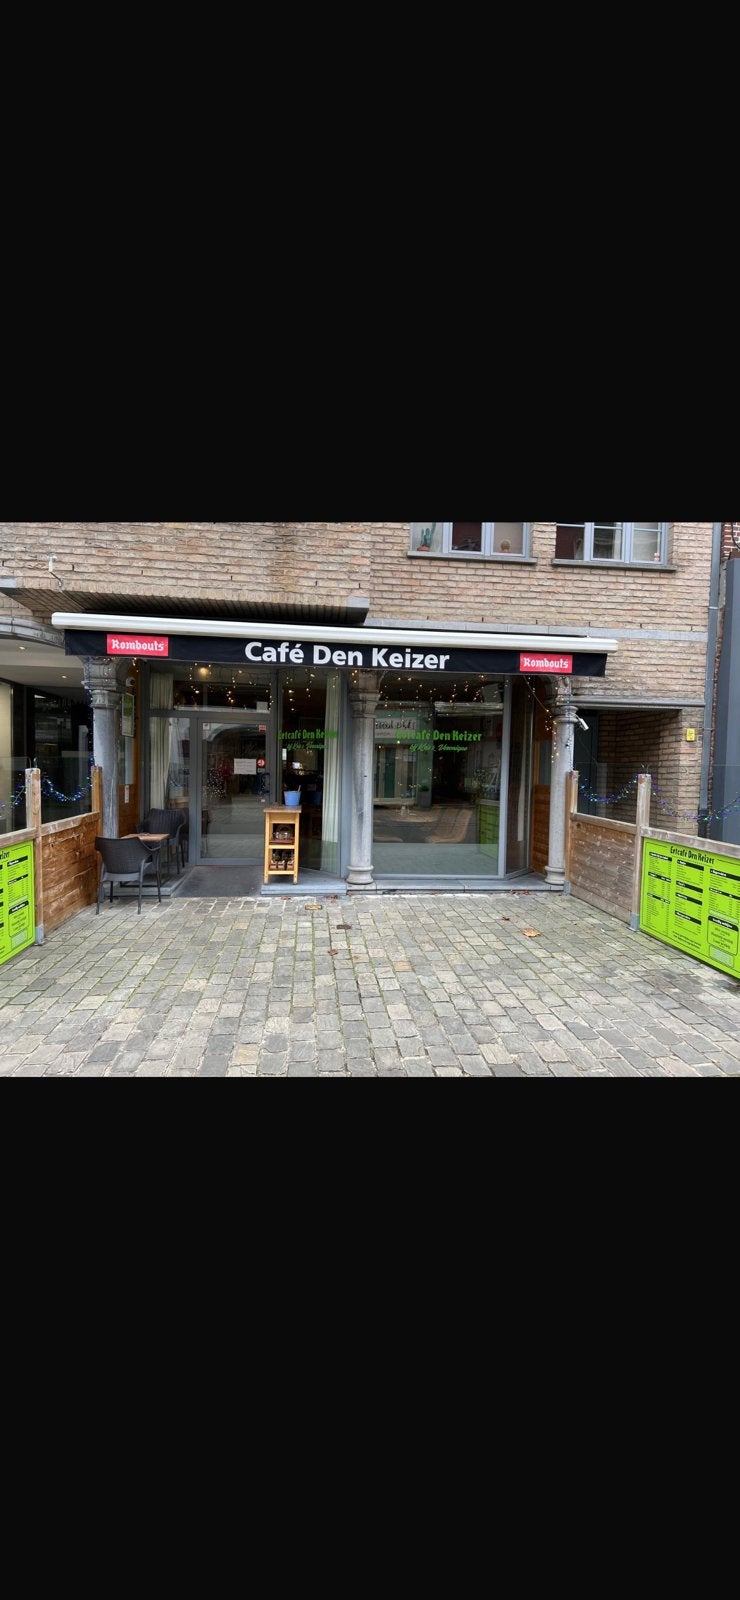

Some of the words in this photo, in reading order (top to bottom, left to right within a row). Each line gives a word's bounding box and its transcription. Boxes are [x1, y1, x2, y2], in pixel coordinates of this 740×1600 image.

[111, 638, 165, 651] Rombouts
[244, 641, 304, 663] Café
[313, 644, 363, 666] Den
[371, 647, 450, 670] Keizer
[523, 657, 569, 669] Rombouts
[302, 728, 315, 740] Den
[433, 729, 451, 741] Den
[452, 729, 482, 742] Keizer
[670, 846, 687, 857] Eetcafé
[688, 850, 697, 860] Den
[698, 852, 715, 865] Keizer
